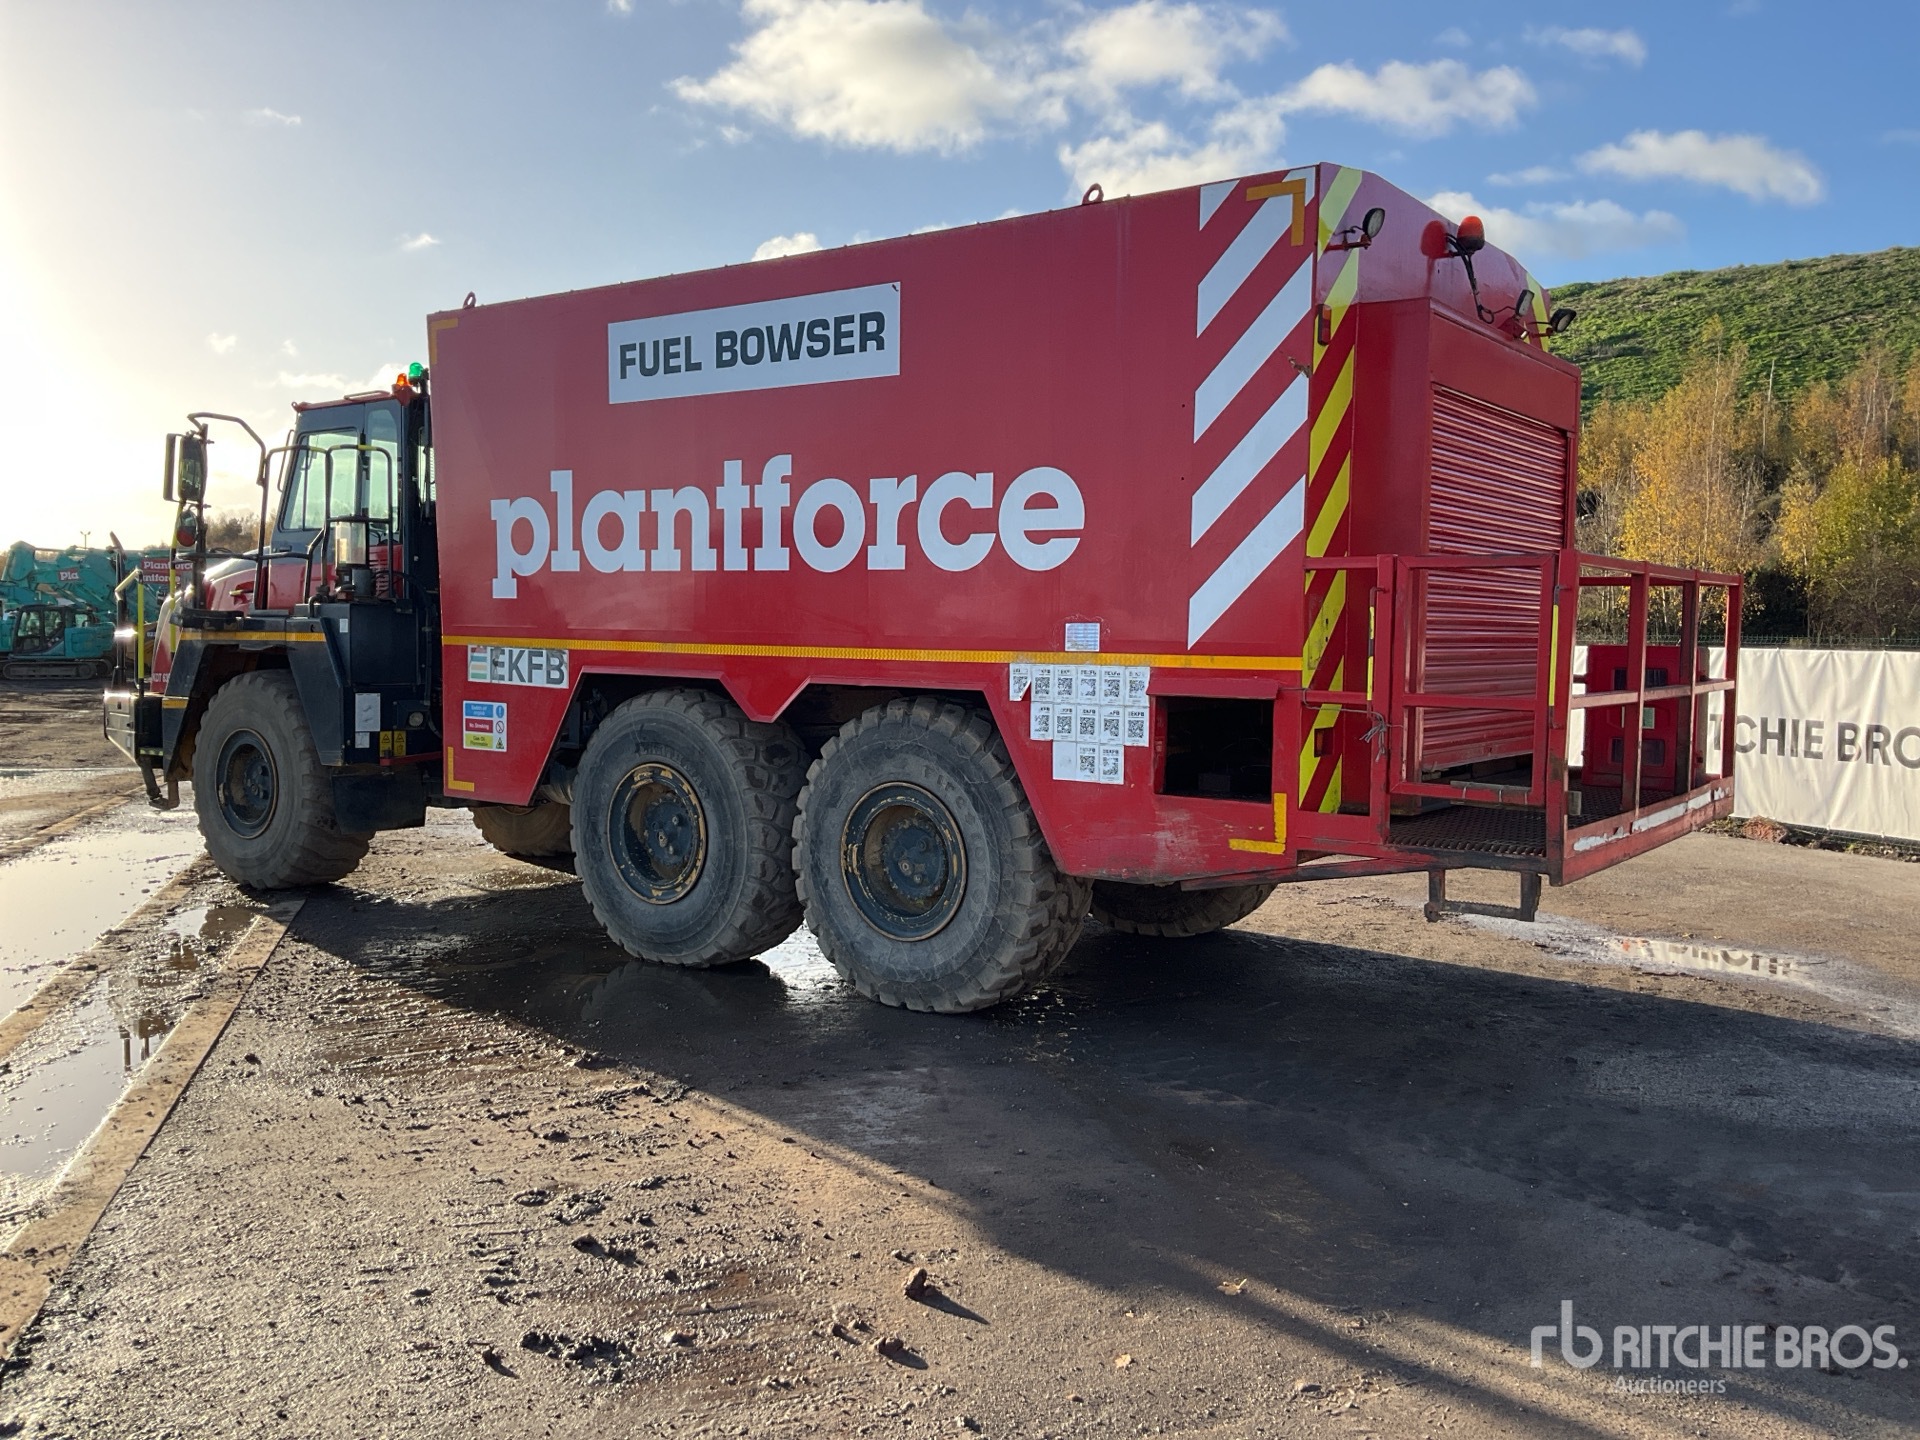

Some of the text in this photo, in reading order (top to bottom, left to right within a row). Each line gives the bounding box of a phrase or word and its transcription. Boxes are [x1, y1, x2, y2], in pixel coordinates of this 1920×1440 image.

[619, 311, 886, 380] FUEL BOWSER
[490, 454, 1086, 599] plantforce
[490, 648, 565, 685] EKFB
[1837, 722, 1920, 769] BRO
